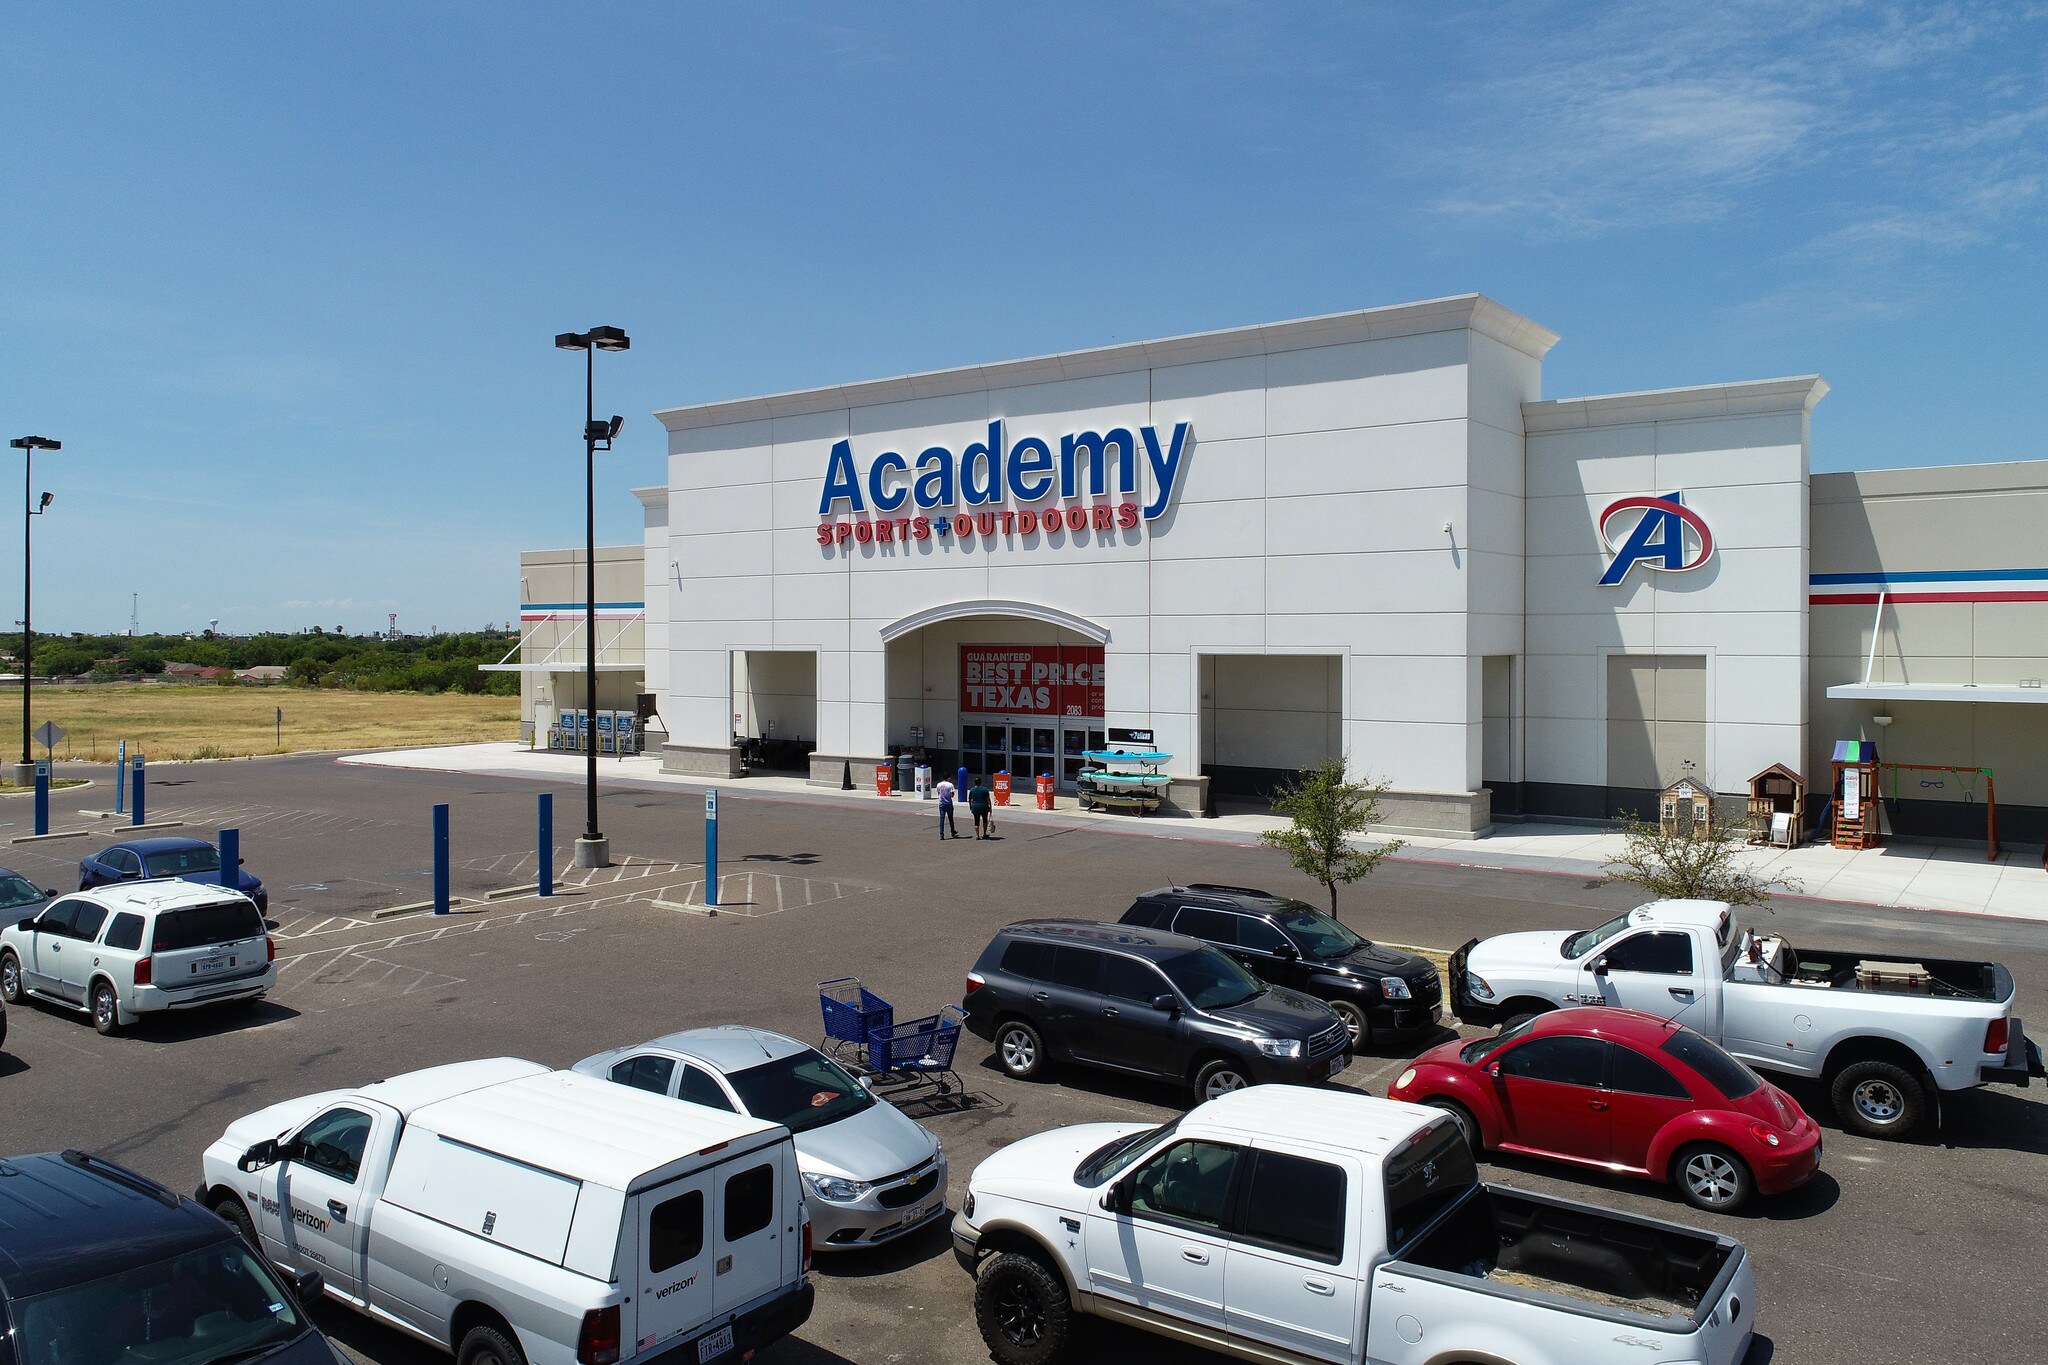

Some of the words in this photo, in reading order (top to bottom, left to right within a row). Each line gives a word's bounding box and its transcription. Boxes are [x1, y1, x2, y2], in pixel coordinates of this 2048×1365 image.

[818, 417, 1192, 521] Academy
[967, 652, 1031, 662] GUARANTEED
[966, 662, 1027, 685] BEST
[1031, 662, 1105, 687] PRICE
[967, 686, 1050, 709] TEXAS
[291, 1206, 327, 1233] verizon
[656, 1276, 694, 1300] verizon
[708, 1331, 722, 1342] TEXAS
